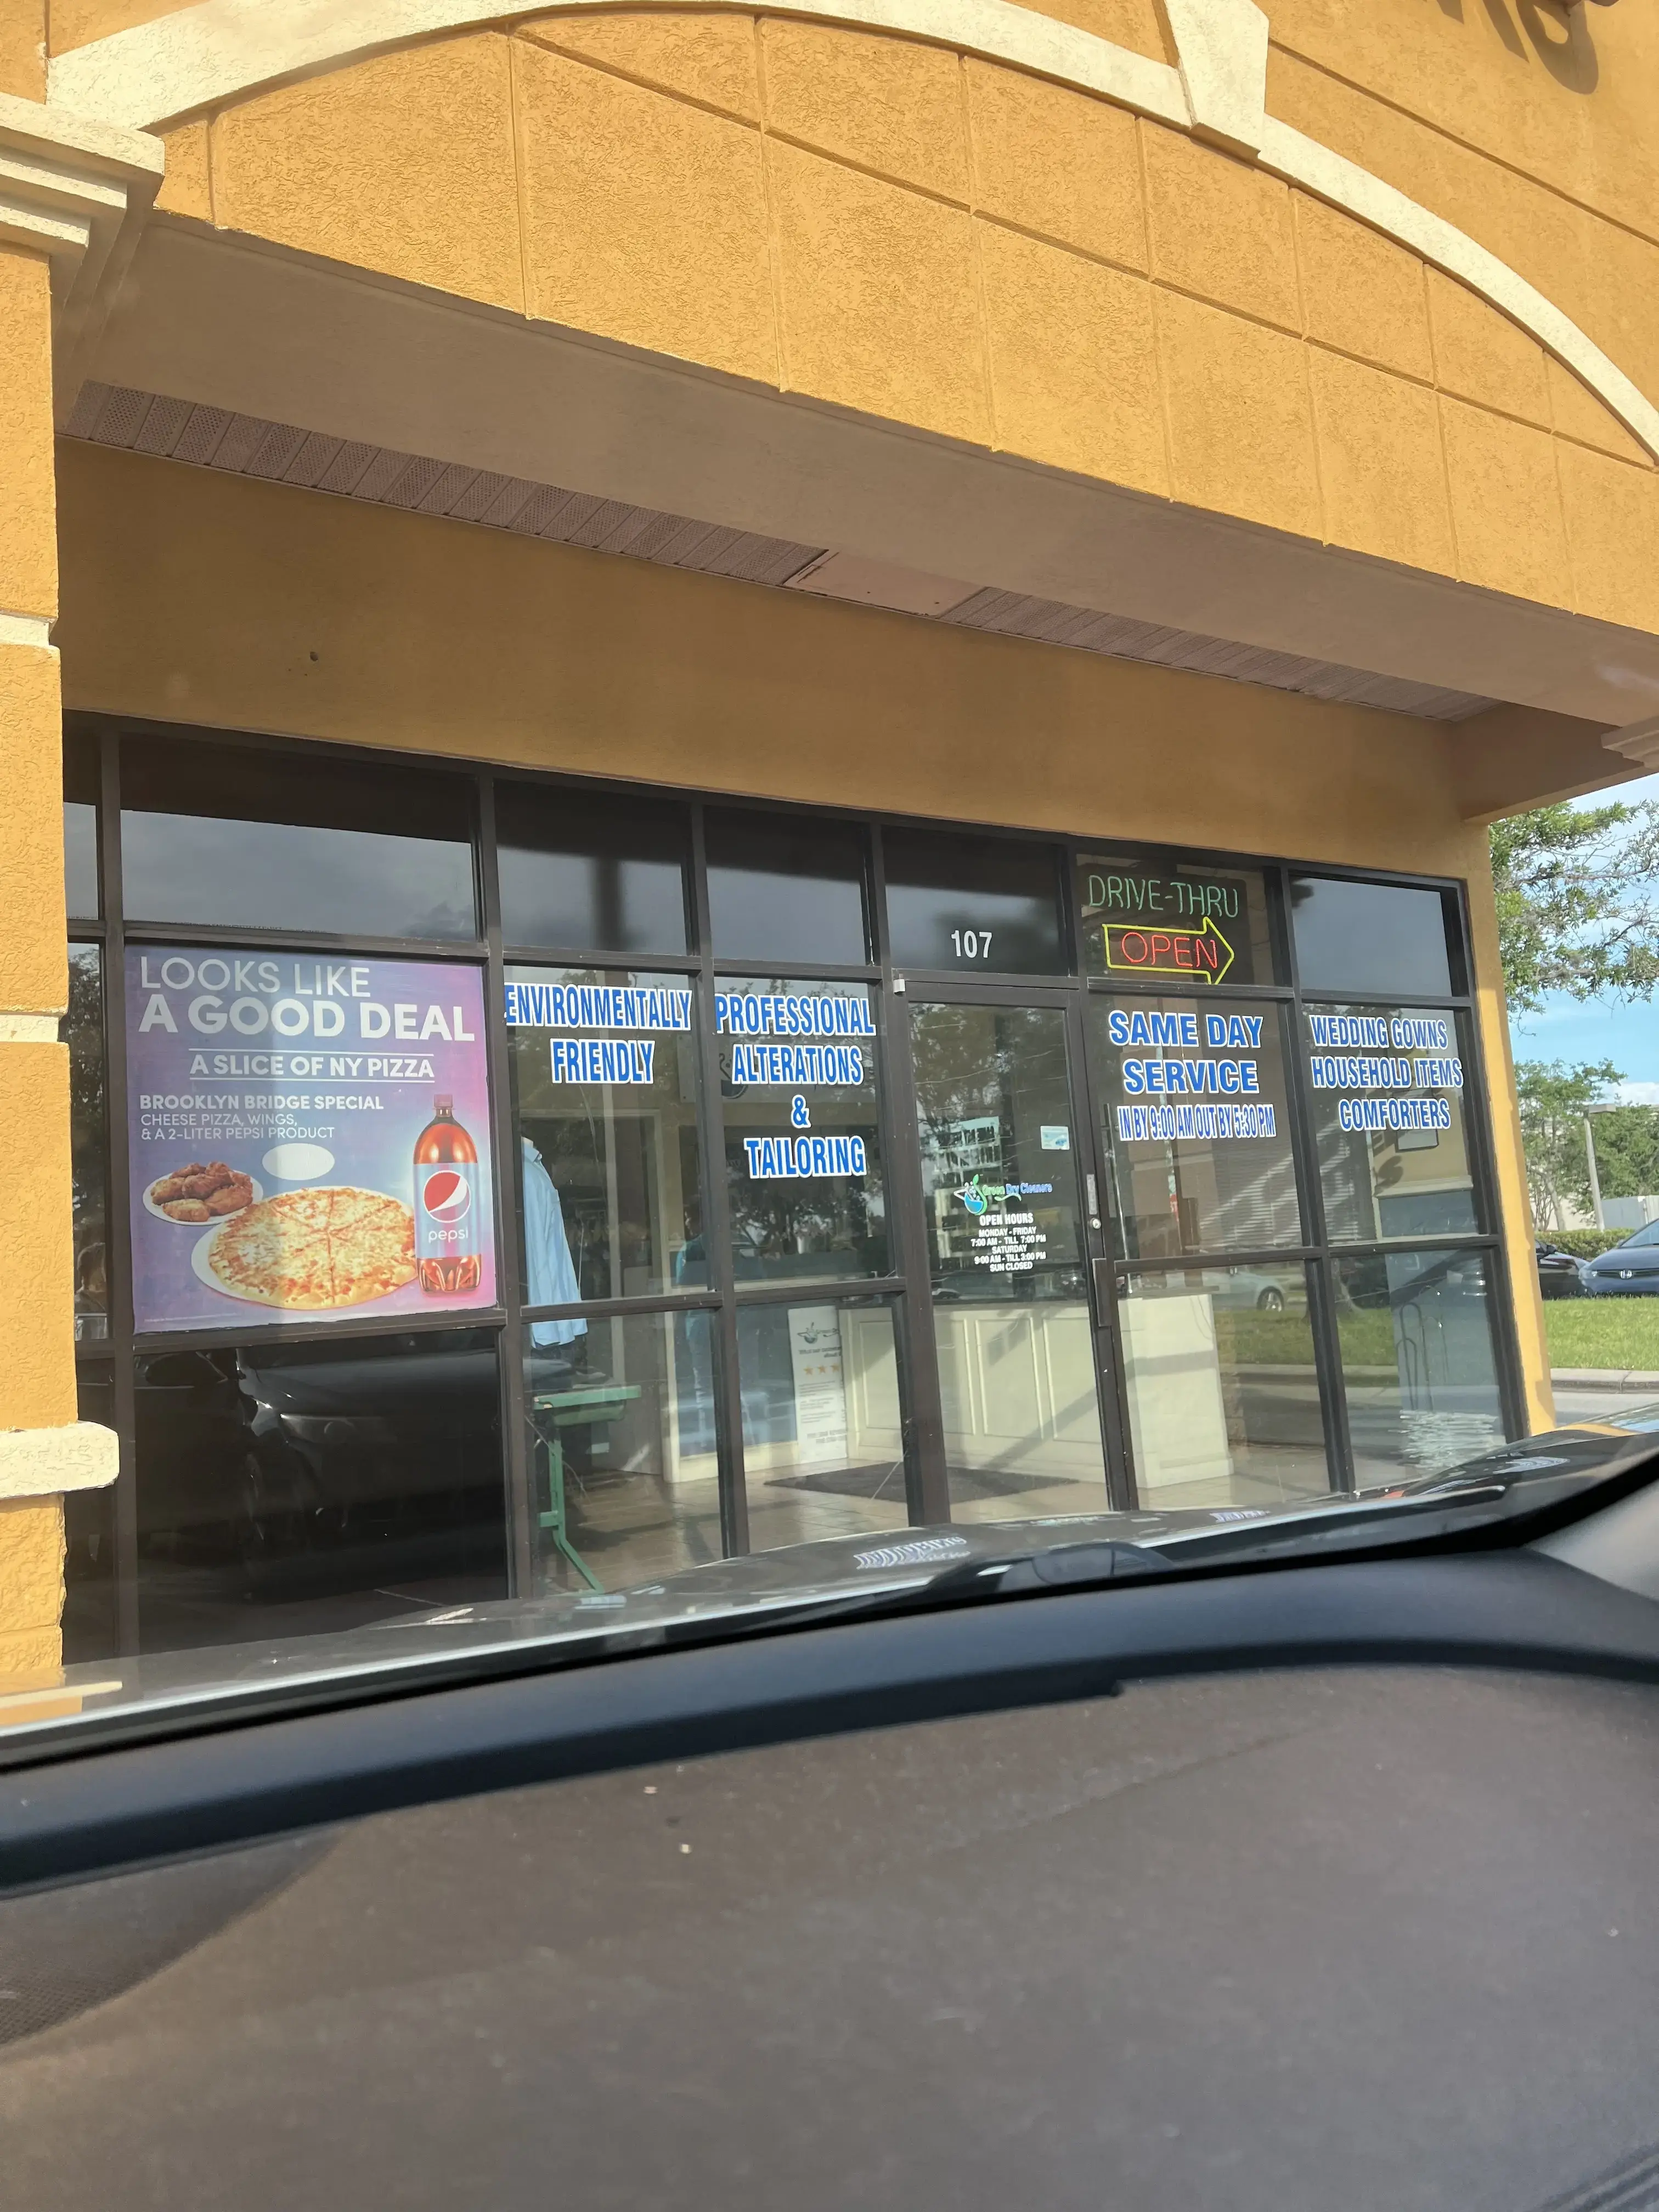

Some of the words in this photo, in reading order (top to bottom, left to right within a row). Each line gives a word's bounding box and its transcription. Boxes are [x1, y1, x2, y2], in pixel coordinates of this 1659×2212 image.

[1088, 874, 1239, 918] DRIVE-THRU
[951, 930, 992, 958] 107
[1121, 932, 1218, 969] OPEN
[141, 956, 281, 993] LOOKS
[294, 963, 371, 997] LIKE
[138, 994, 178, 1032] A
[188, 995, 345, 1037] GOOD
[360, 1002, 475, 1041] DEAL
[504, 983, 692, 1030] ENVIRONMENTALLY
[715, 994, 876, 1036] PROFESSIONAL
[1109, 1009, 1199, 1047] SAME
[1205, 1014, 1263, 1048] DAY
[1309, 1014, 1389, 1048] WEDDING
[1391, 1018, 1448, 1050] GOWNS
[189, 1054, 210, 1075] A
[213, 1055, 284, 1075] SLICE
[290, 1056, 324, 1076] OF
[330, 1057, 363, 1076] NY
[368, 1058, 435, 1078] PIZZA
[550, 1038, 656, 1084] FRIENDLY
[732, 1044, 864, 1085] ALTERATIONS
[1122, 1059, 1260, 1094] SERVICE
[1311, 1056, 1412, 1089] HOUSEHOLD
[1413, 1058, 1464, 1088] ITEMS
[139, 1095, 239, 1109] BROOKLYN
[244, 1095, 311, 1109] BRIDGE
[314, 1096, 384, 1110] SPECIAL
[791, 1094, 811, 1128] &
[1338, 1098, 1451, 1132] COMFORTERS
[140, 1114, 196, 1126] CHEESE
[201, 1114, 244, 1127] PIZZA,
[247, 1113, 297, 1126] WINGS,
[141, 1128, 151, 1140] &
[154, 1128, 166, 1140] A
[168, 1127, 222, 1139] 2-LITER
[225, 1127, 264, 1139] PEPSI
[268, 1127, 335, 1138] PRODUCT
[1117, 1105, 1133, 1141] IN
[1132, 1105, 1149, 1141] BY
[1149, 1105, 1176, 1140] 9:00
[1176, 1104, 1196, 1139] AM
[1195, 1104, 1218, 1139] OUT
[1216, 1104, 1233, 1138] BY
[1232, 1104, 1259, 1139] 5:30
[1257, 1103, 1277, 1138] PM
[744, 1135, 867, 1179] TAILORING
[1006, 1183, 1019, 1194] Dry
[428, 1226, 469, 1244] pepsi
[978, 1228, 1008, 1237] MONDAY
[1012, 1226, 1037, 1235] FRIDAY
[979, 1214, 1003, 1226] OPEN
[1005, 1212, 1034, 1224] HOURS
[970, 1238, 986, 1247] 7:00
[1003, 1236, 1019, 1244] TILL
[1020, 1235, 1035, 1244] 7:00
[1035, 1234, 1046, 1243] PM
[991, 1244, 1028, 1254] SATURDAY
[1005, 1254, 1020, 1262] TILL
[1035, 1251, 1046, 1260] PM
[989, 1263, 1005, 1272] SUN
[1005, 1261, 1033, 1271] CLOSED
